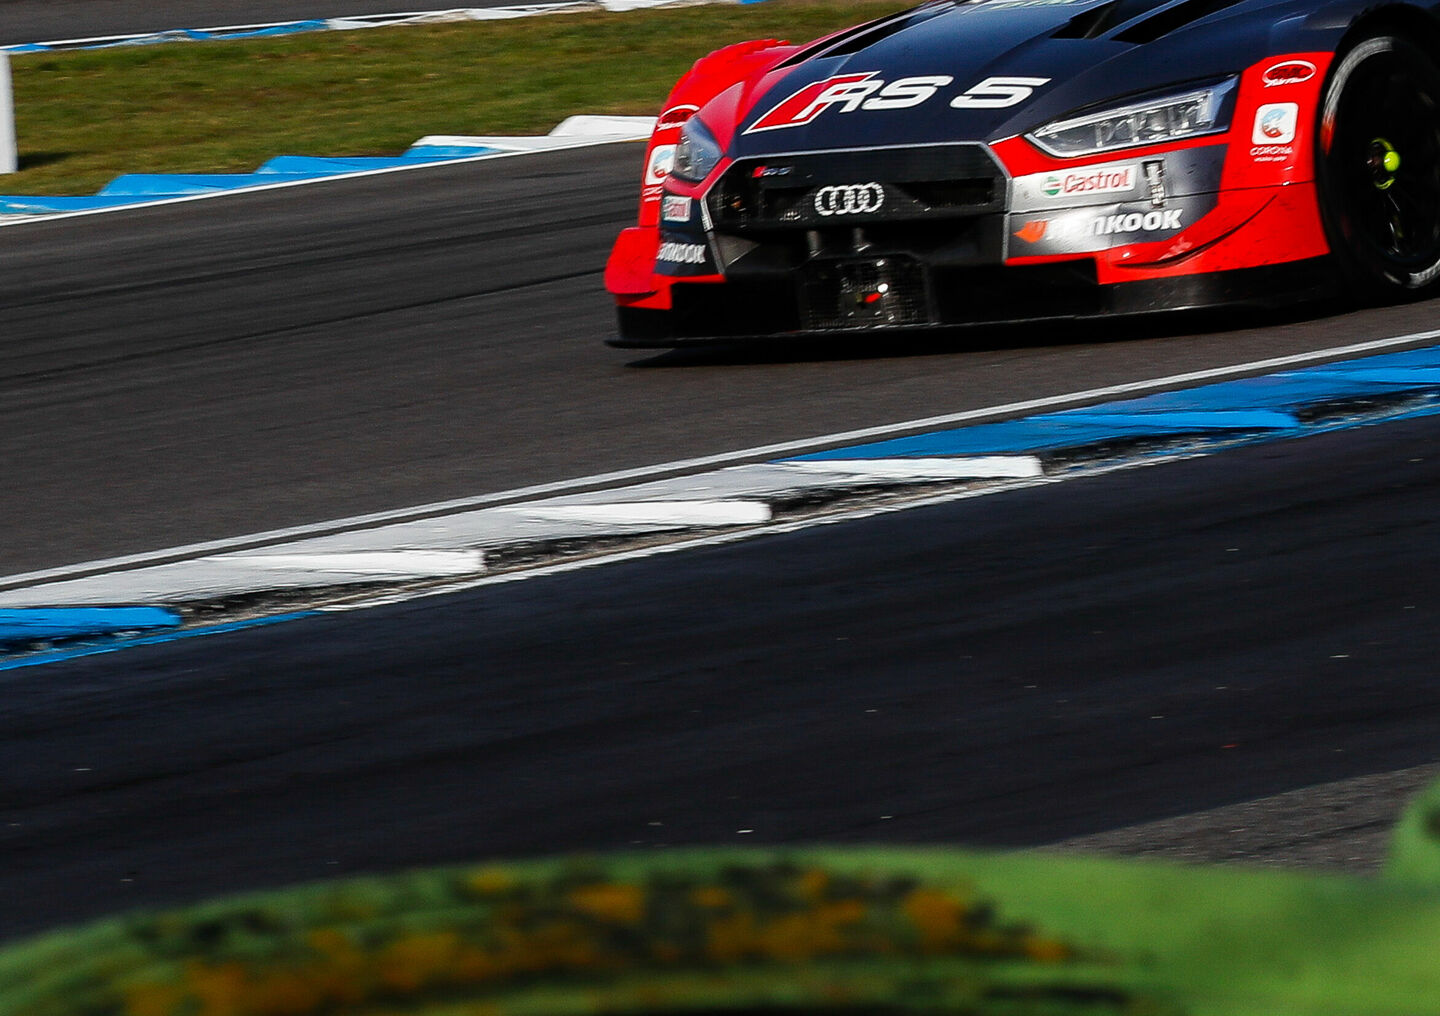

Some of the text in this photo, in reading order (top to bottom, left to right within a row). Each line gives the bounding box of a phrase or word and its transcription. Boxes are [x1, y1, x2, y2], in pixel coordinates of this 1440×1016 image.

[778, 72, 1053, 124] RS 5
[1063, 169, 1130, 193] Castrol
